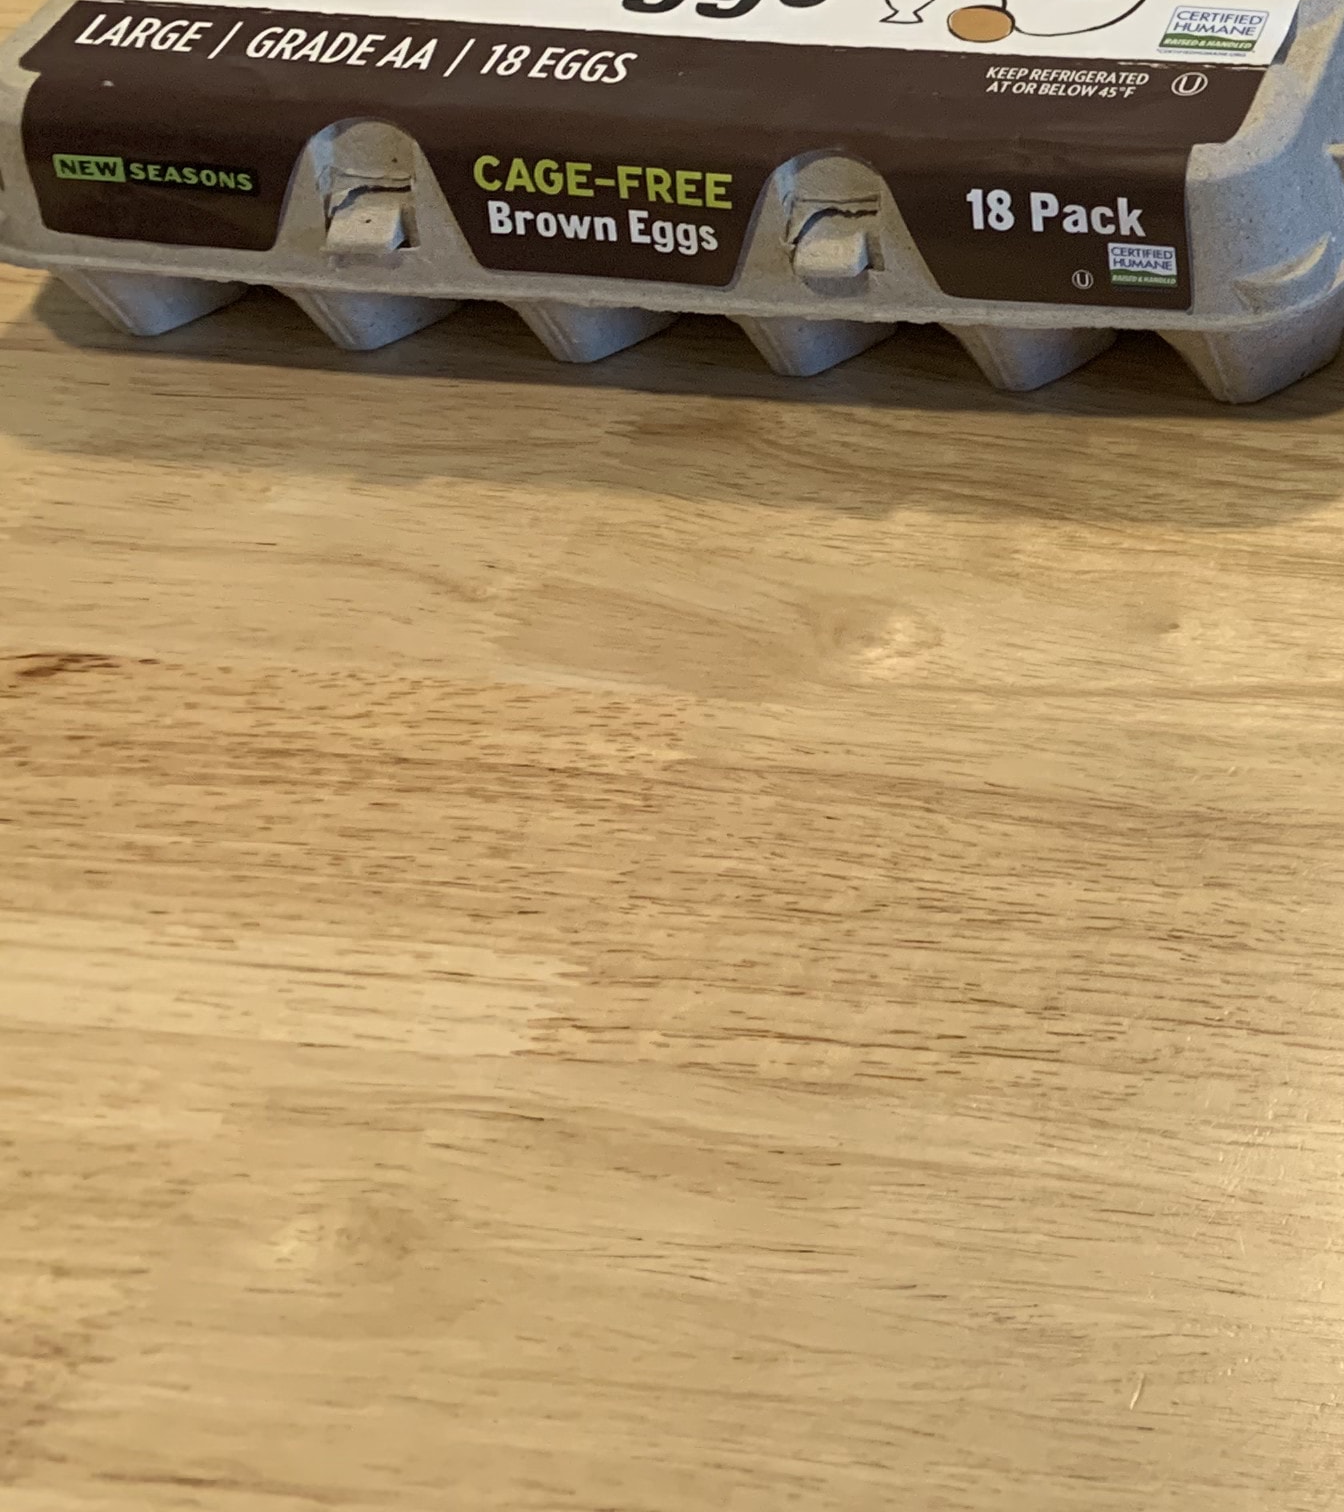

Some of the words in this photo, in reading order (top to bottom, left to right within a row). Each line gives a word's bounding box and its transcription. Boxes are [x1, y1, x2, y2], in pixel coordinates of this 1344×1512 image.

[1176, 10, 1263, 26] CERTIFIED
[1173, 20, 1258, 37] HUMANE
[74, 13, 214, 54] LARGE
[245, 26, 388, 69] GRADE
[376, 38, 440, 70] AA
[479, 43, 533, 76] 18
[527, 46, 639, 85] EGGS
[985, 66, 1029, 81] KEEP
[1030, 68, 1150, 86] REFRIGERATED
[985, 81, 1012, 94] AT
[1012, 82, 1038, 95] OR
[1038, 83, 1098, 97] BELOW
[58, 157, 121, 178] NEW
[128, 162, 254, 191] SEASONS
[473, 154, 733, 210] CAGE-FREE
[965, 188, 1016, 232] 18
[1030, 191, 1146, 238] Pack
[487, 199, 618, 242] Brown
[627, 209, 719, 256] Eggs
[1110, 246, 1173, 260] CERTIFIED
[1112, 258, 1173, 271] HUMANE
